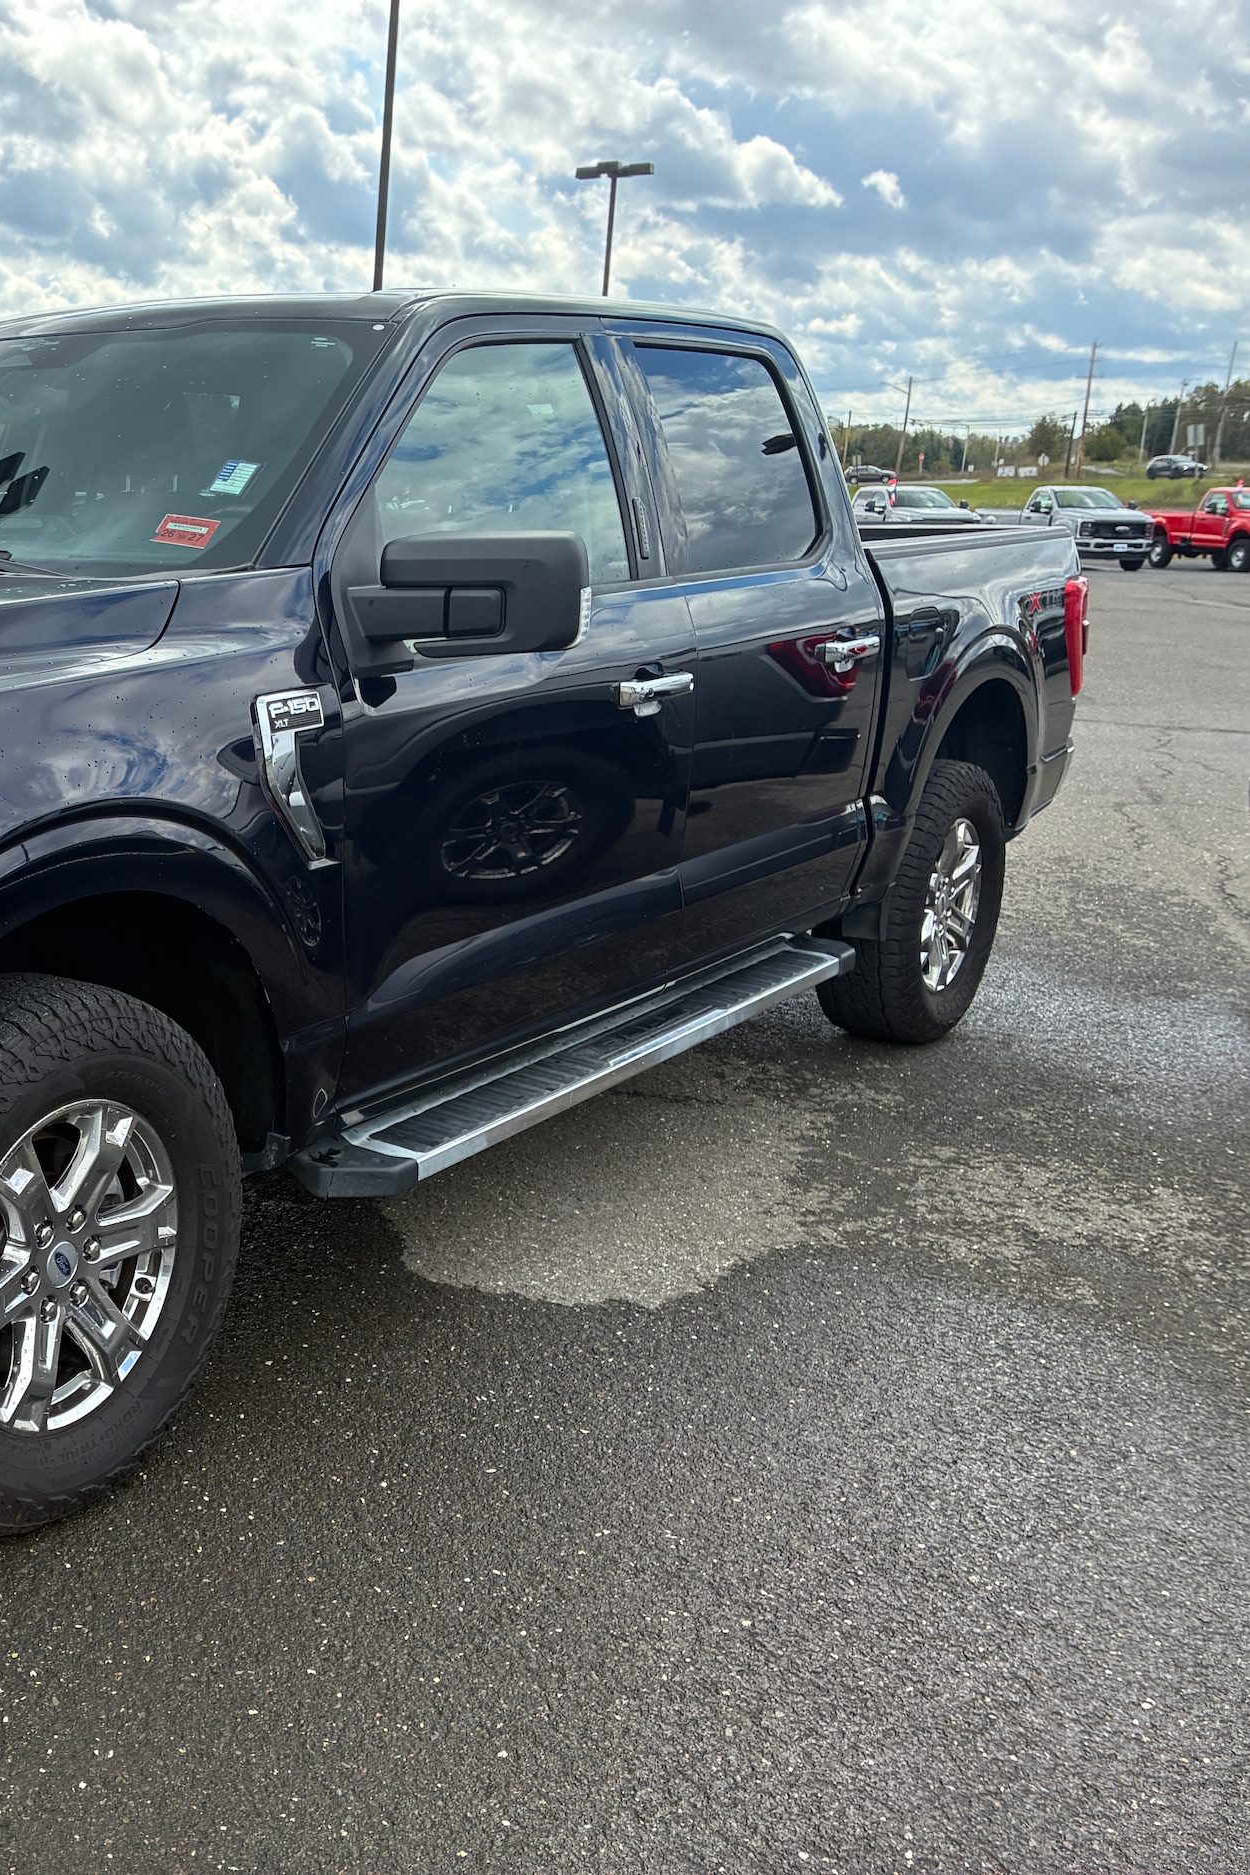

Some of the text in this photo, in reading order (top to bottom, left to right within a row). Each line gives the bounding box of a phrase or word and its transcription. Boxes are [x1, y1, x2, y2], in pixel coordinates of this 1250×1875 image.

[161, 529, 175, 538] 26
[188, 533, 205, 541] 27
[268, 697, 319, 718] F-150
[274, 718, 289, 729] XLT
[181, 1163, 219, 1347] COOPER
